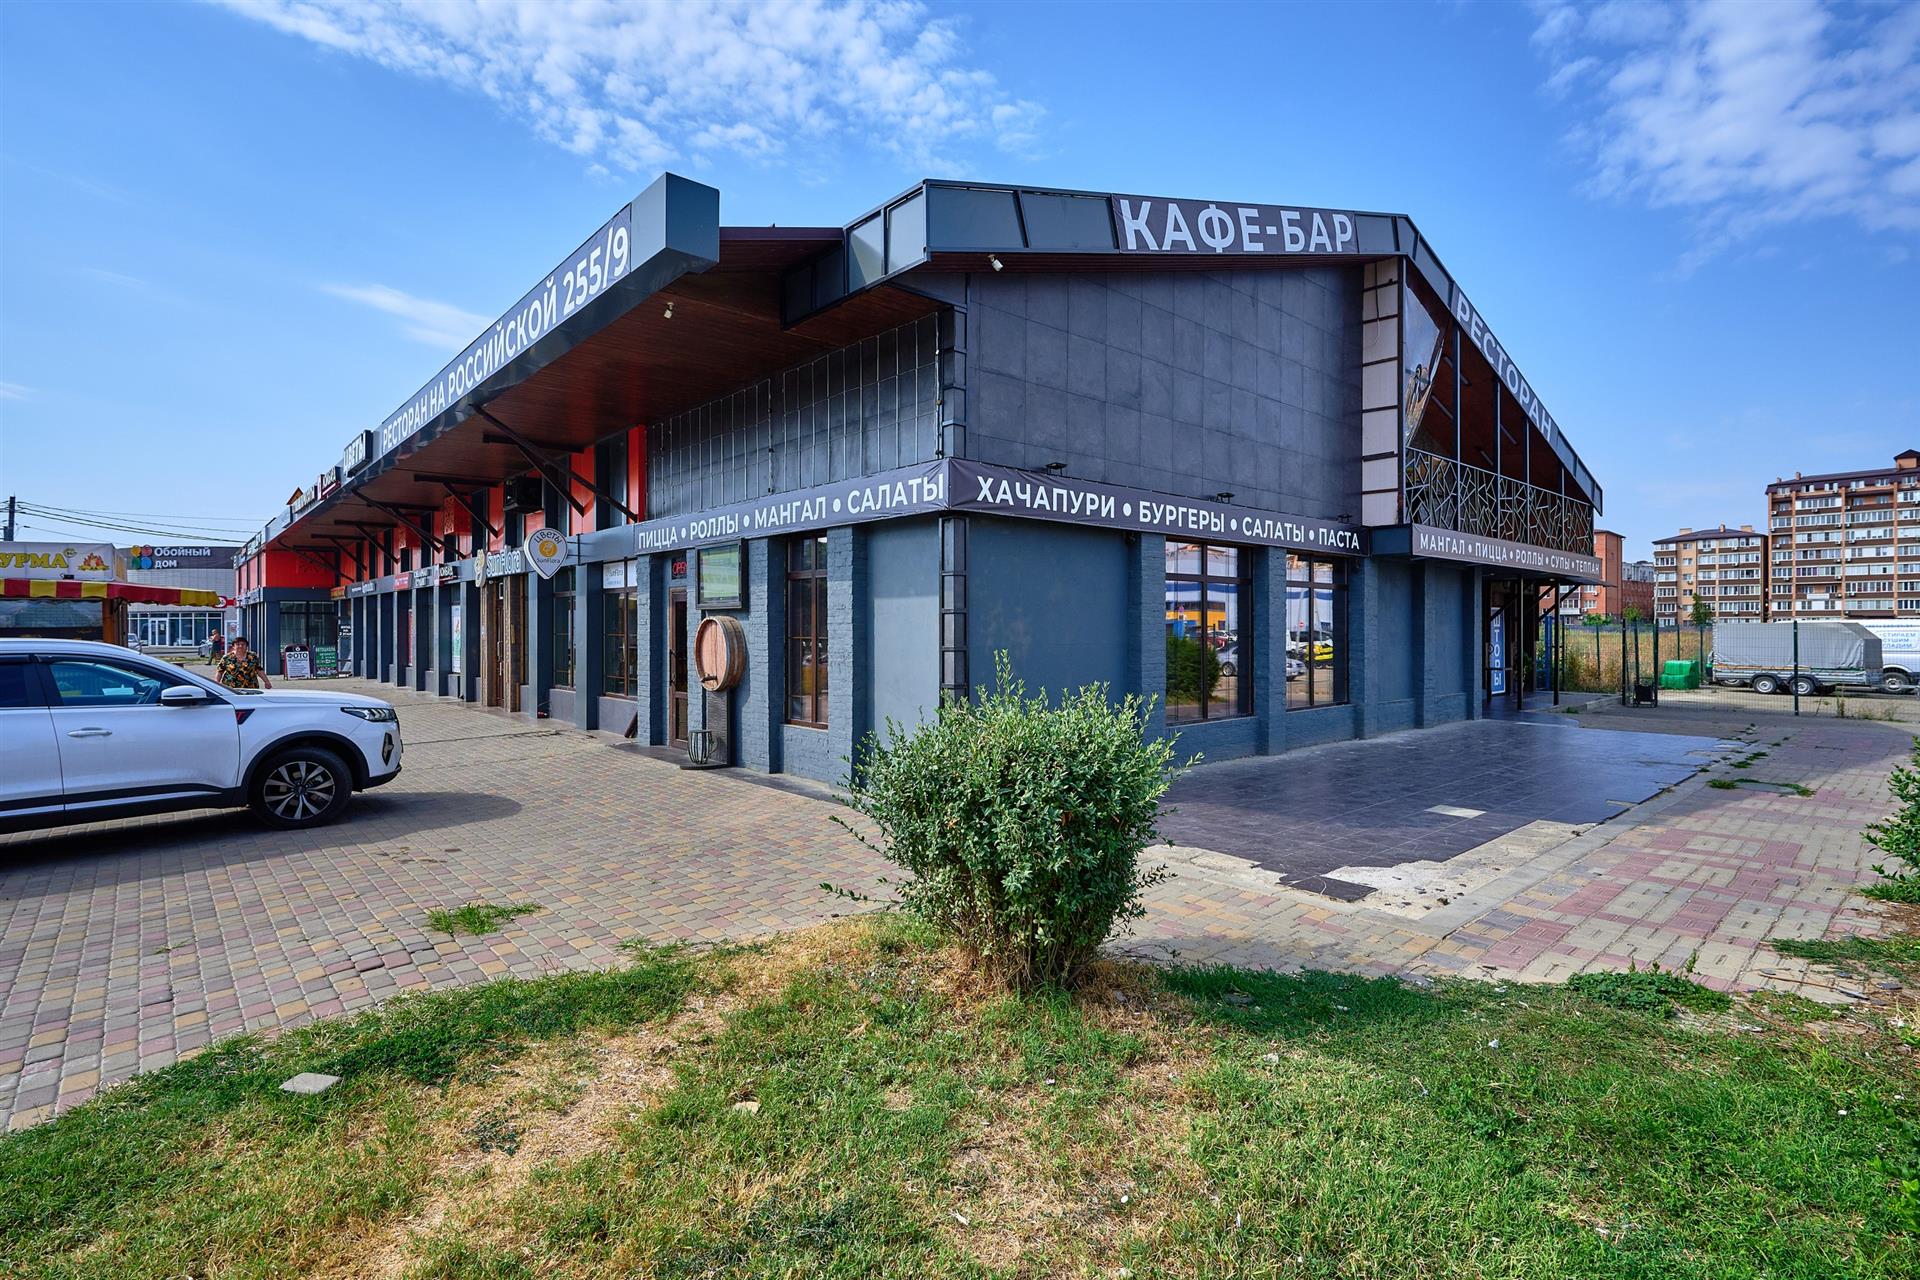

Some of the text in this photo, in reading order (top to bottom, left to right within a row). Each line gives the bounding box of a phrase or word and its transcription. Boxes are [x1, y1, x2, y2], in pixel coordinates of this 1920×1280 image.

[1119, 199, 1353, 253] КАФЕ-БАР
[382, 226, 628, 454] РЕСТОРАН НА РОССИЙСКОЙ 255/9
[1456, 291, 1552, 441] РЕСТОРАН
[638, 473, 944, 549] ПИЦЦА РОЛЛЫ МАНГАЛ САЛАТЫ
[976, 475, 1360, 550] ХАЧАПУРИ БУРГЕРЫ САЛАТЫ ПАСТА
[154, 546, 211, 557] Обойный
[154, 559, 177, 569] дом
[1420, 533, 1600, 574] МАНГАЛ ПИЦЦА РОЛЛЫ СУПЫ ТЕППАН
